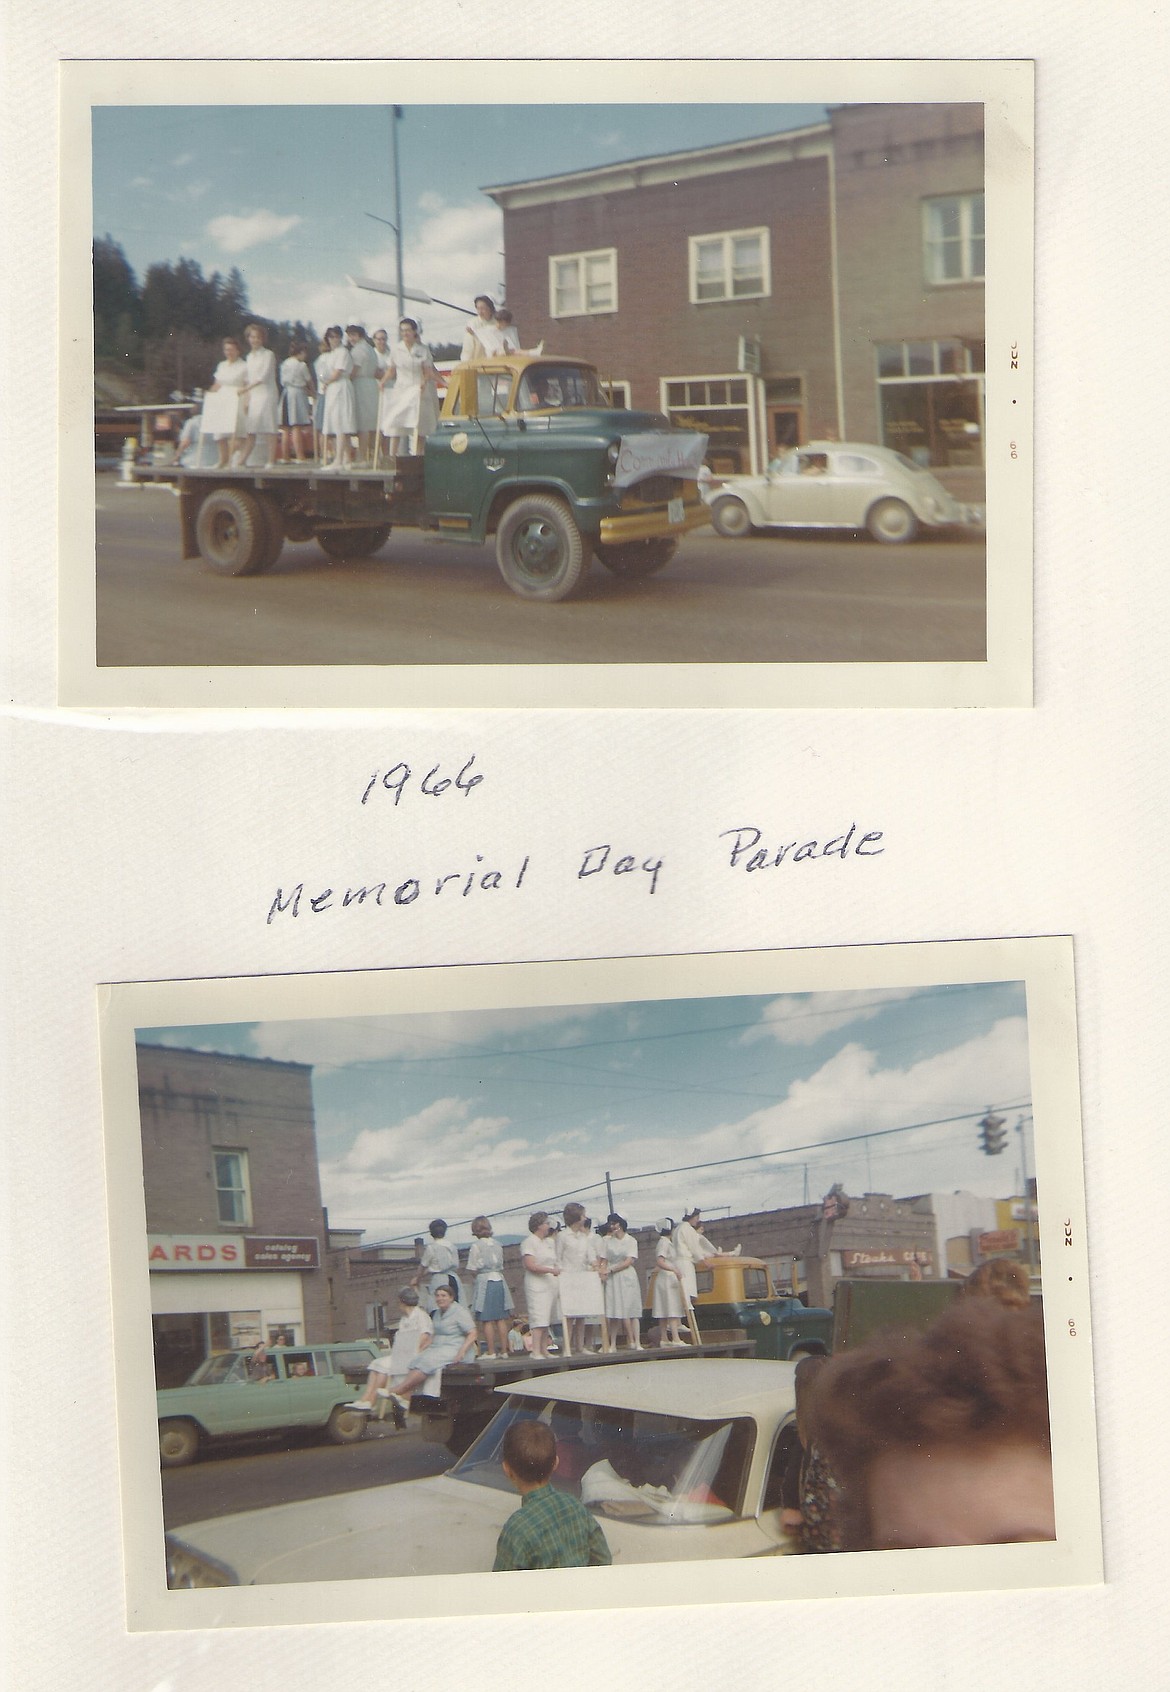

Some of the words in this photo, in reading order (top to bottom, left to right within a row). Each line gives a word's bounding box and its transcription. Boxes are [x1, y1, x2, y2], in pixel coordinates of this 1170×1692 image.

[360, 753, 485, 806] 1966
[266, 854, 530, 925] Memorial
[577, 844, 664, 895] Day
[718, 821, 885, 873] Parade
[150, 1244, 238, 1262] ARDS
[280, 1252, 312, 1263] agency
[850, 1251, 897, 1265] Steaks
